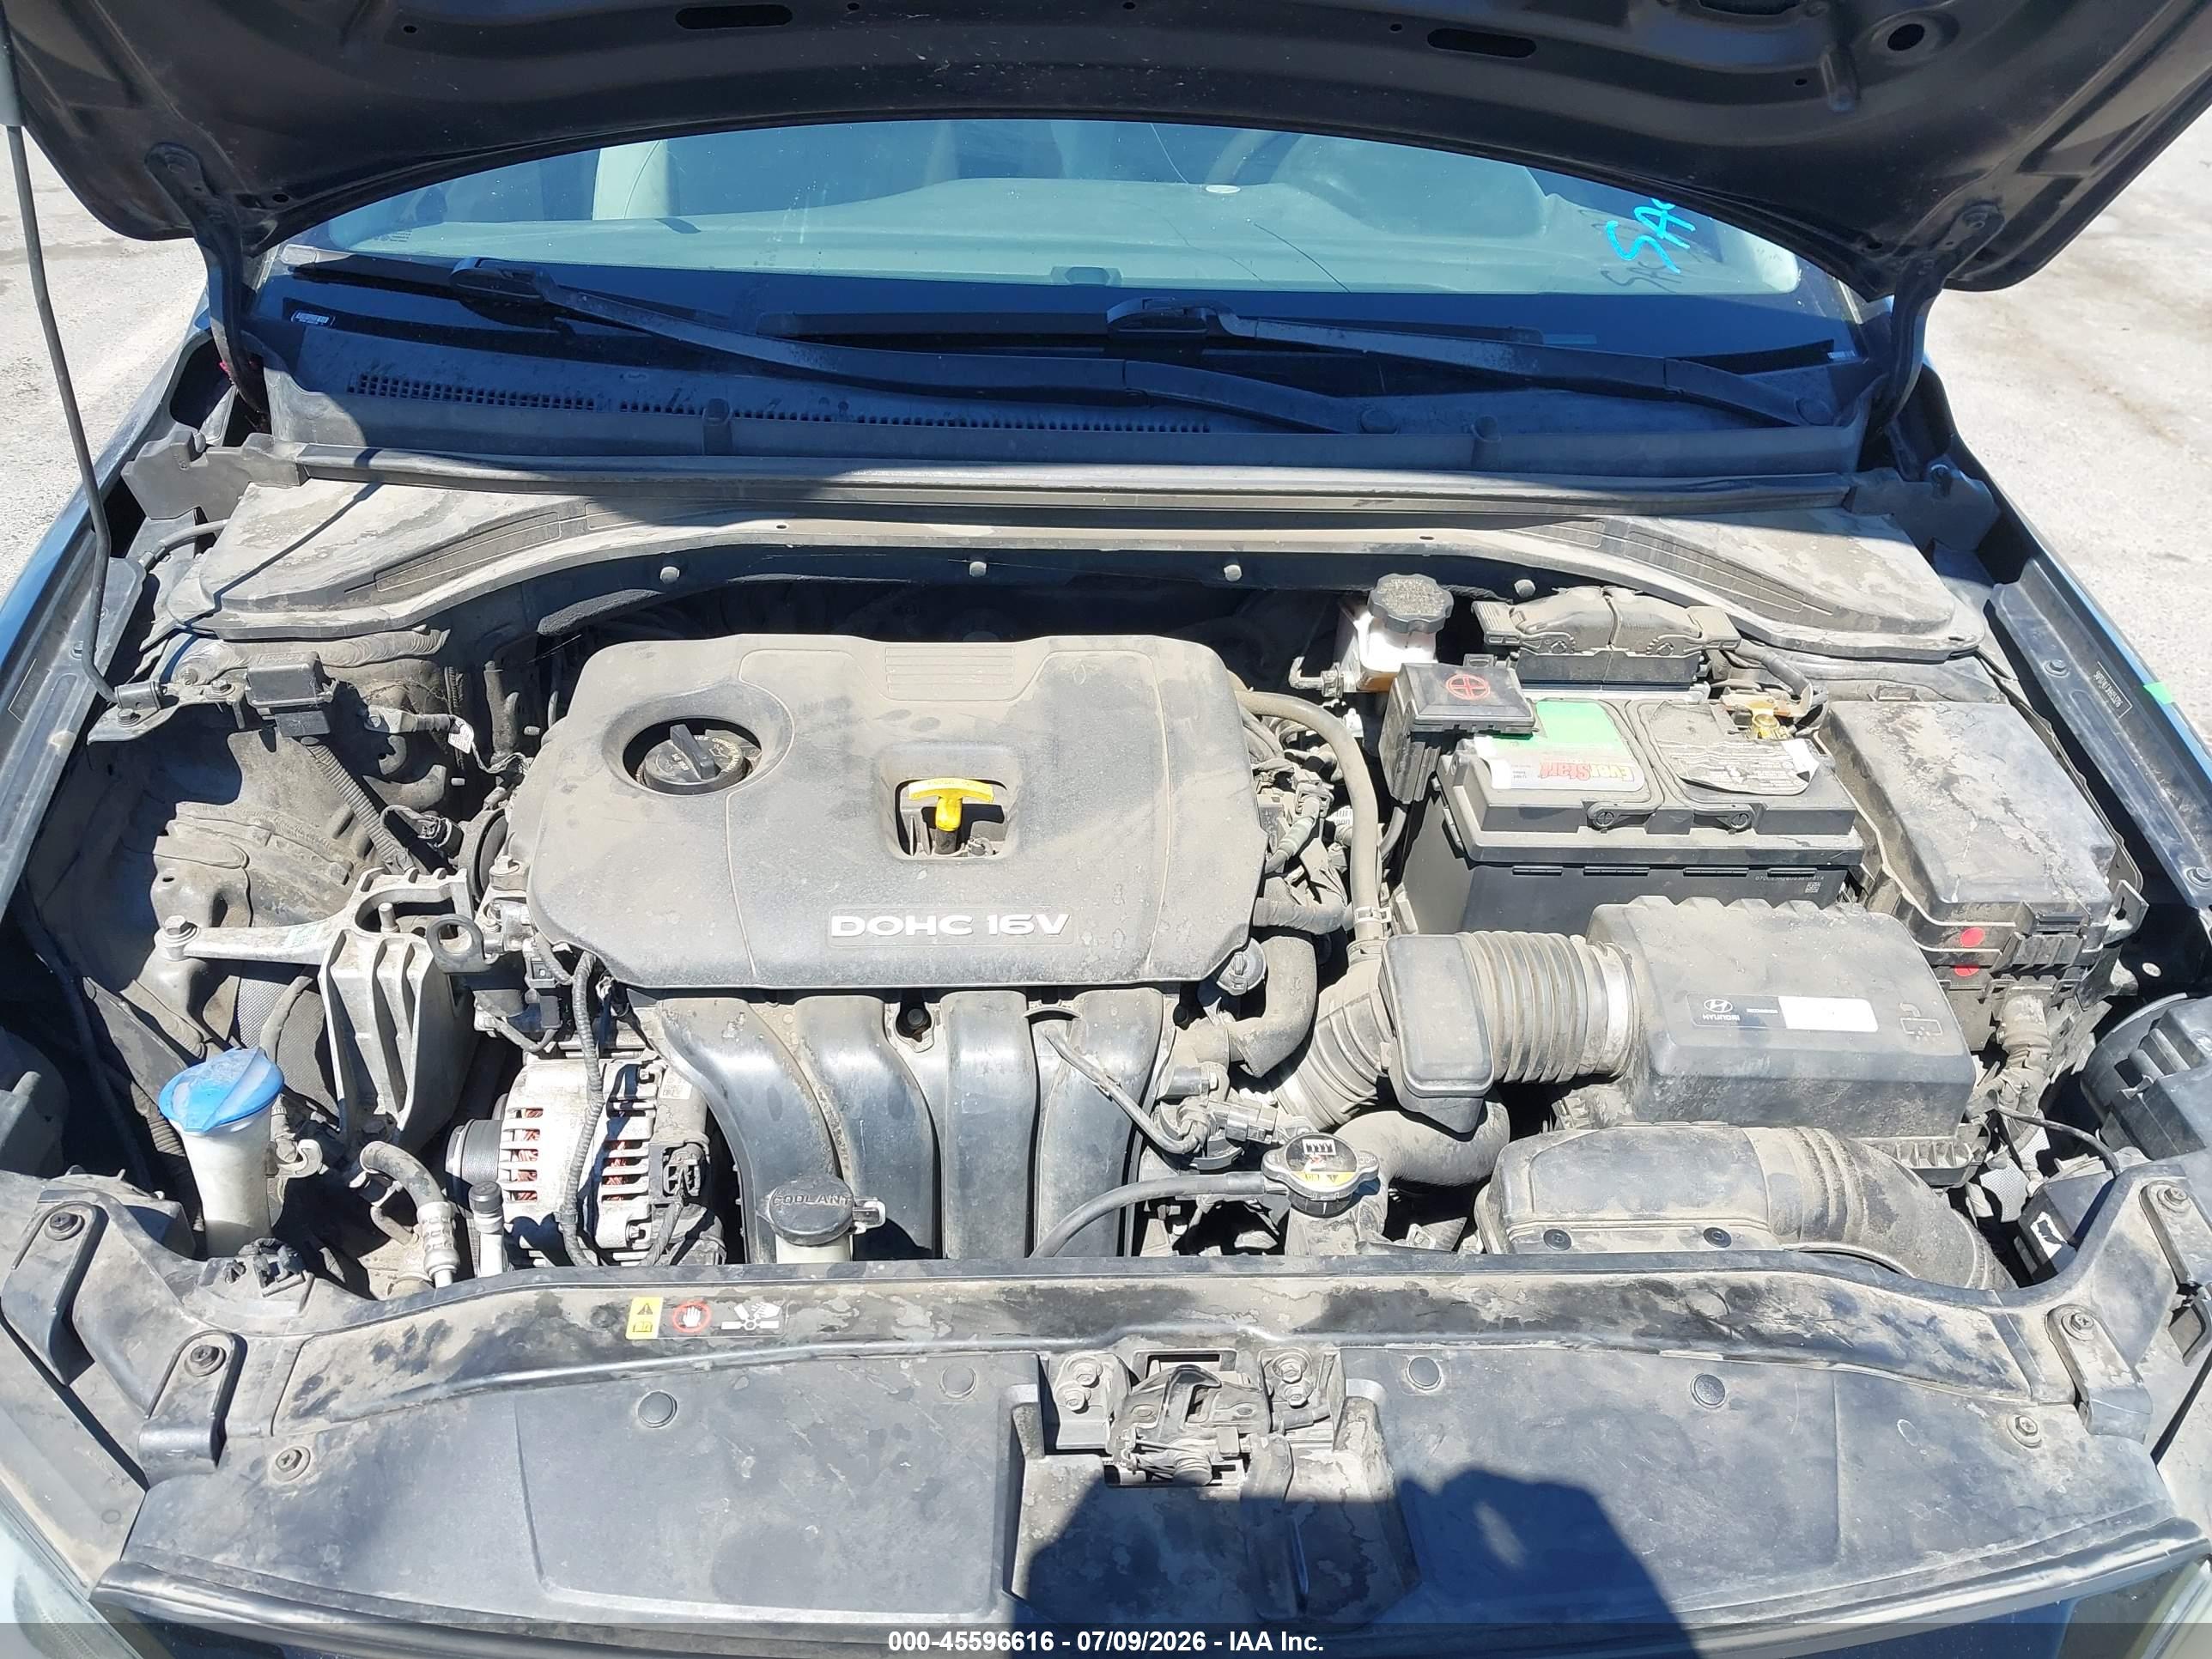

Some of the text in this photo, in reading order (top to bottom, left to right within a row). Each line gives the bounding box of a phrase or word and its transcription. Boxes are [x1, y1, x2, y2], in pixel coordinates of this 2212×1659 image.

[1540, 762, 1636, 781] EverStart
[831, 914, 1071, 937] DOHC 16V
[773, 1194, 852, 1206] COOLANT
